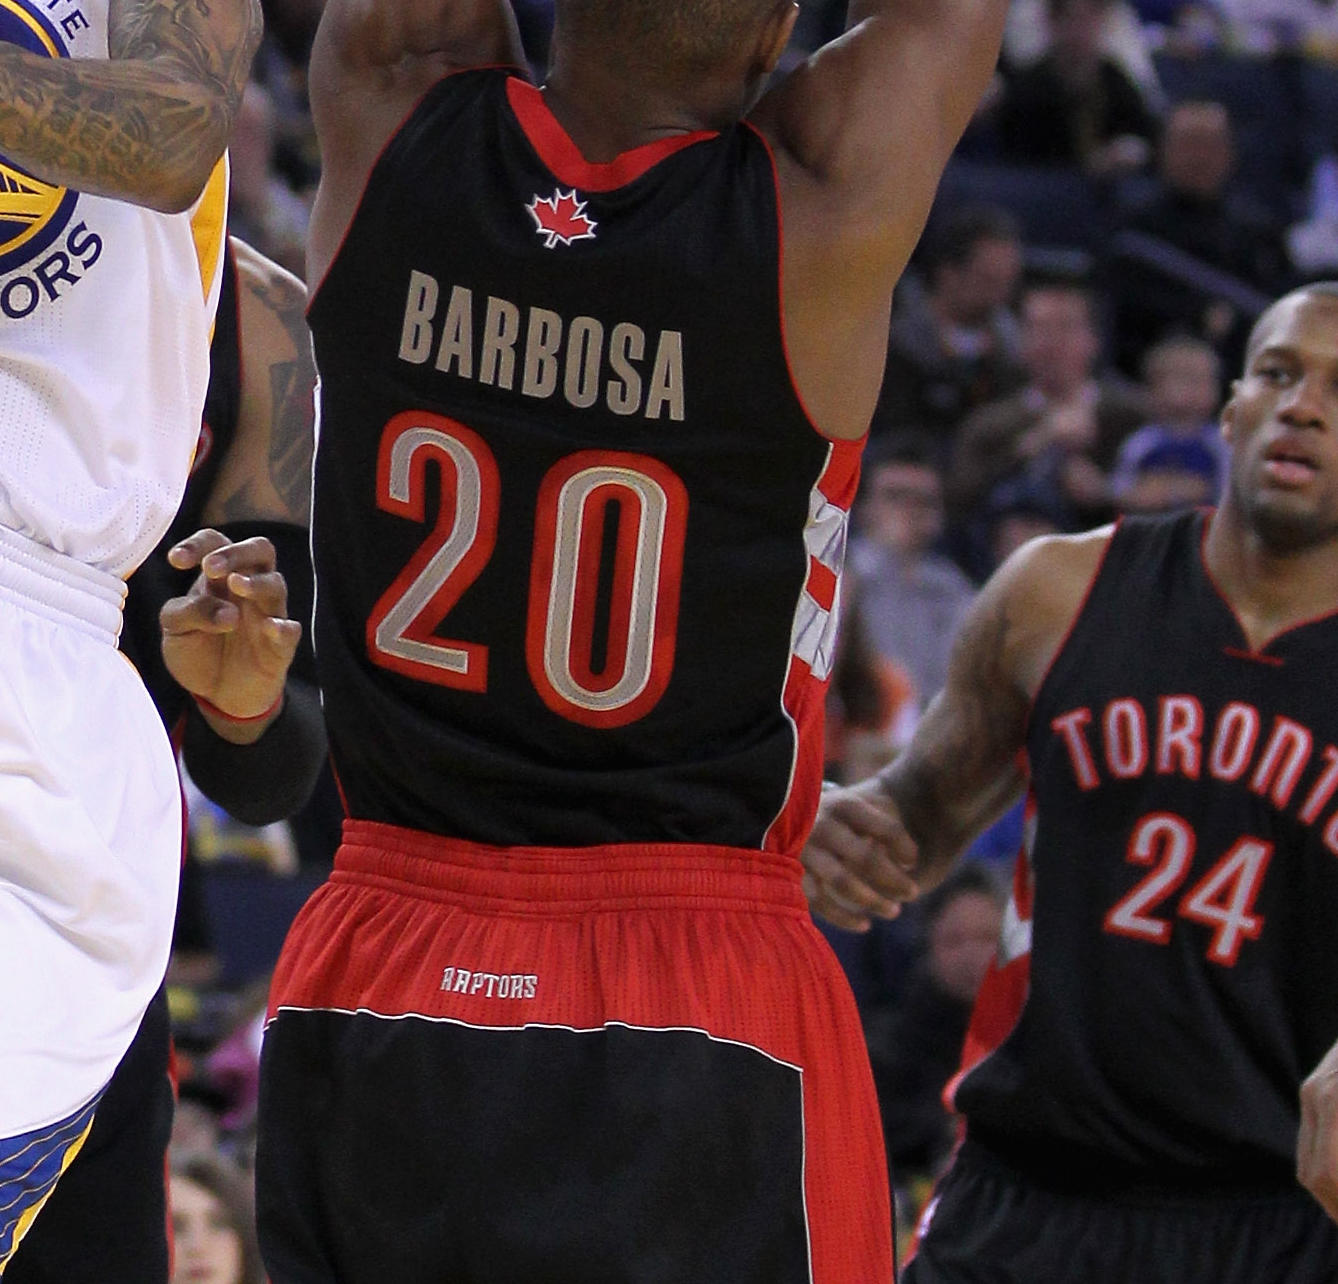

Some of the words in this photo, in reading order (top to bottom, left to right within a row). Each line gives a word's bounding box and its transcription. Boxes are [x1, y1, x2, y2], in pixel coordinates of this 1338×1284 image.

[398, 270, 685, 422] BARBOSA
[366, 410, 690, 729] 20
[1103, 810, 1275, 968] 24
[440, 966, 539, 999] RAPTORS
